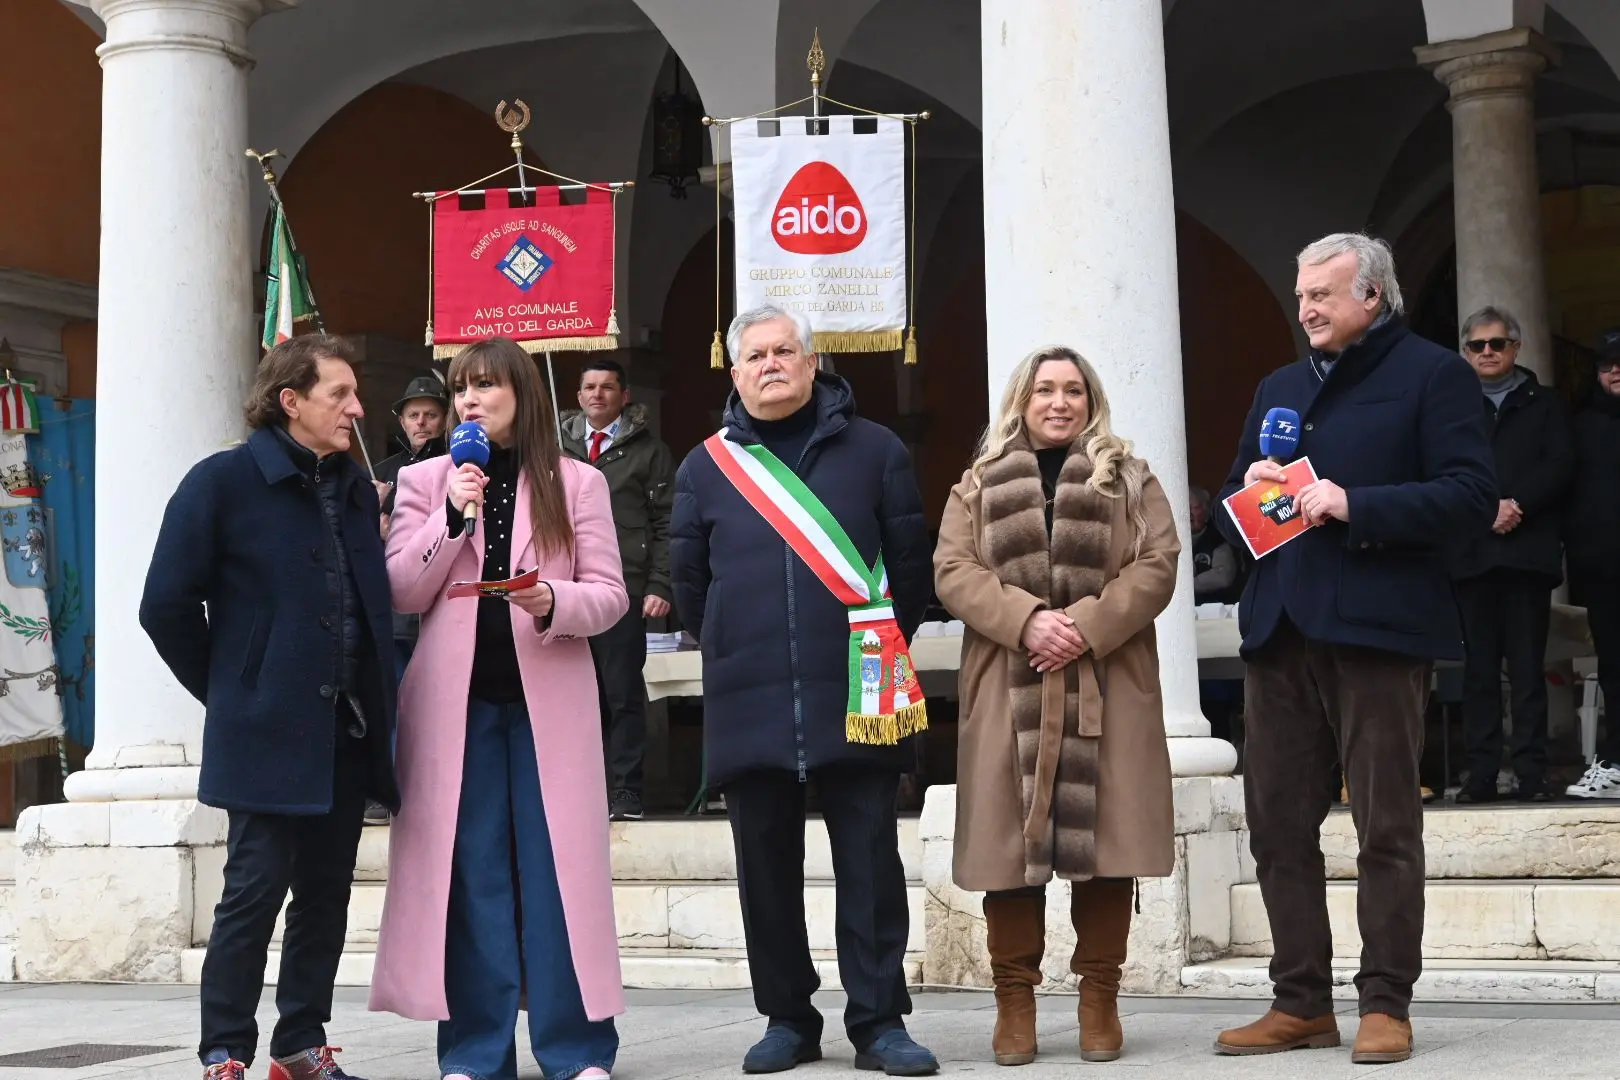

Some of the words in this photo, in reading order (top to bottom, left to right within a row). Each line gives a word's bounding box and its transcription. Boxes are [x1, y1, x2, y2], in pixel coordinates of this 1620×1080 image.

[776, 194, 861, 236] aido
[470, 228, 501, 260] CHARITAS
[501, 220, 525, 234] USQUE
[528, 220, 539, 231] AD
[540, 222, 578, 254] SANGUINEM
[749, 268, 806, 281] GRUPPO
[811, 266, 893, 279] COMUNALE
[765, 284, 812, 297] MIRCO
[818, 283, 880, 296] ZANELLI
[474, 306, 504, 320] AVIS
[508, 301, 578, 317] COMUNALE
[808, 302, 825, 312] DEL
[827, 300, 865, 312] GARDA
[460, 322, 514, 337] LONATO
[518, 320, 542, 333] DEL
[546, 317, 593, 331] GARDA
[1260, 501, 1277, 514] PIAZZA
[1277, 504, 1293, 521] NOI
